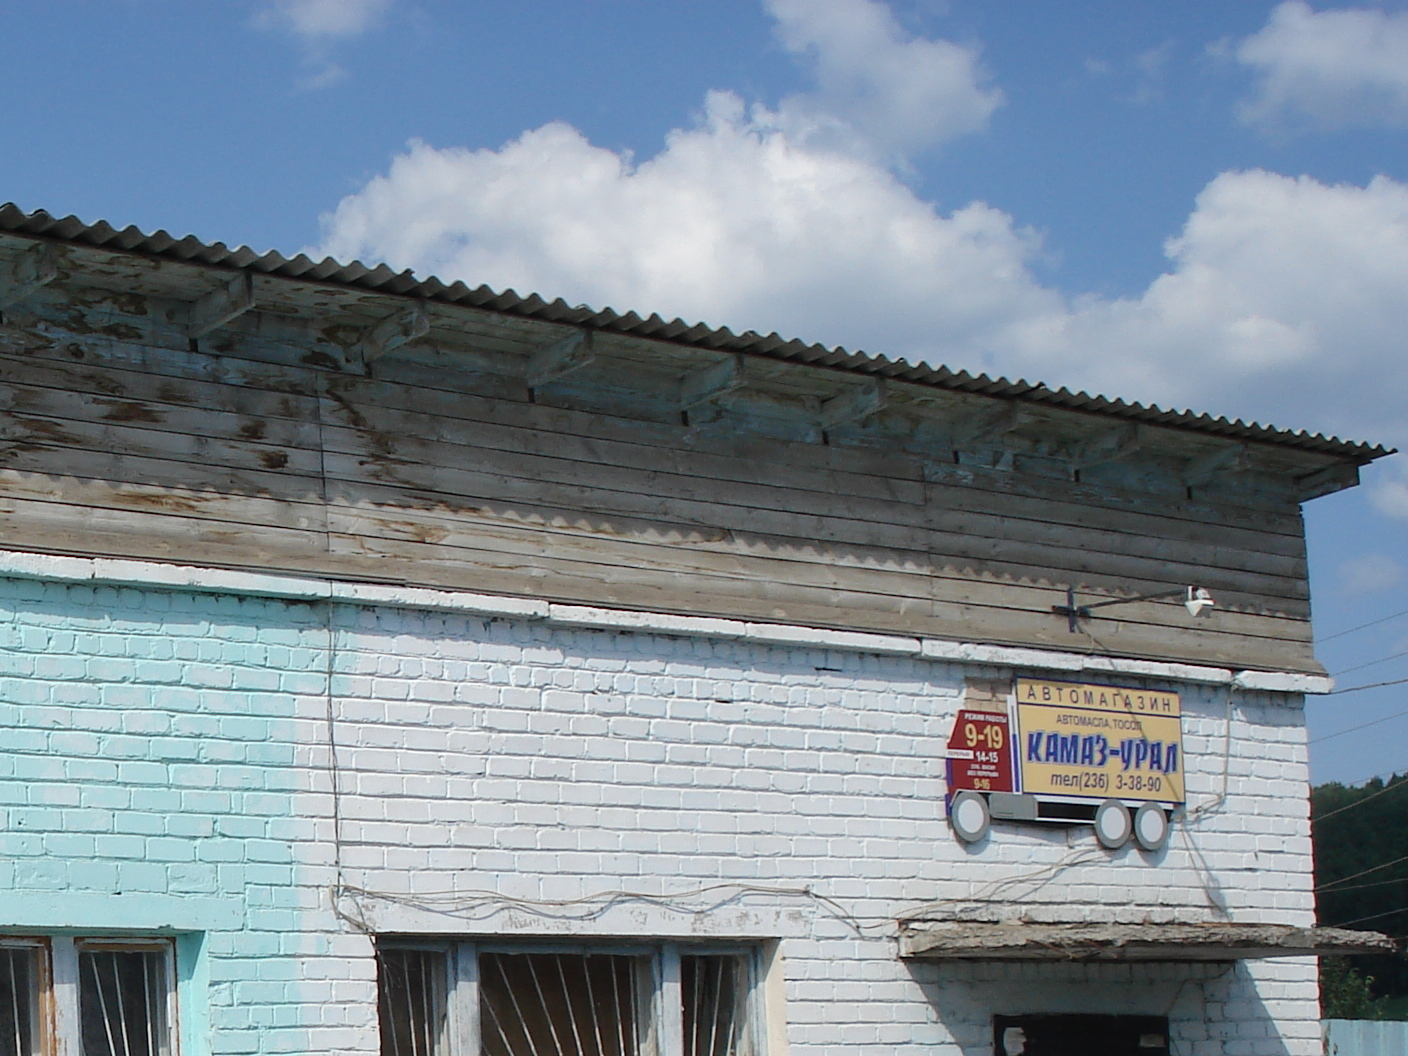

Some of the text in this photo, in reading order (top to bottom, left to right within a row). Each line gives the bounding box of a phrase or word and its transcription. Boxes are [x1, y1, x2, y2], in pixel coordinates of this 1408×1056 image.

[1027, 685, 1171, 712] АВТОМАГАЗИН
[965, 723, 1003, 749] 9-19
[976, 751, 998, 763] 14-15
[1027, 730, 1178, 775] КАМАЗ-УРАЛ
[1116, 774, 1161, 792] 3-38-90
